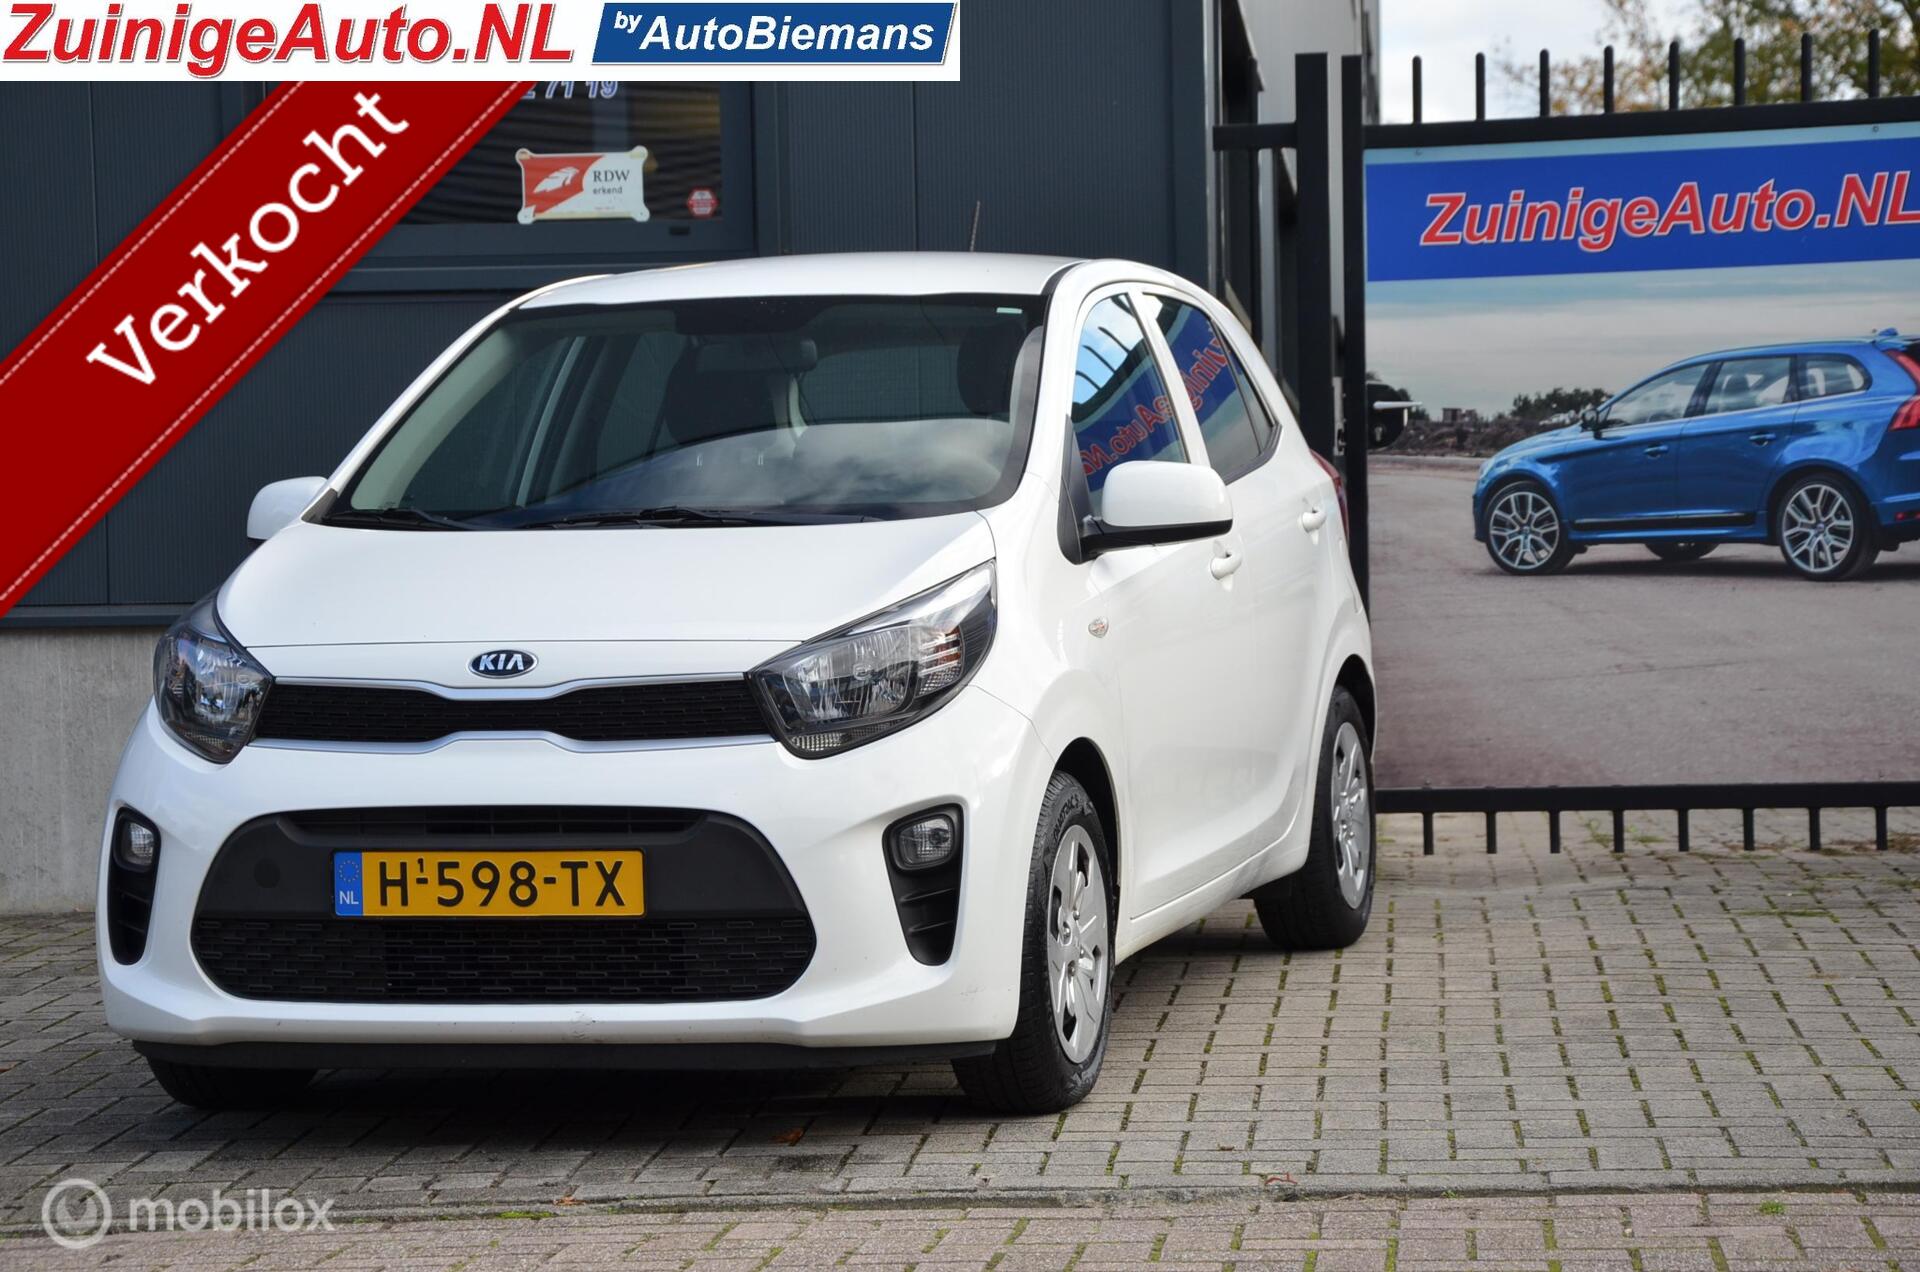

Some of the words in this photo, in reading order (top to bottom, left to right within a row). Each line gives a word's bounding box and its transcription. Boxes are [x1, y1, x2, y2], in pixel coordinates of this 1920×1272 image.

[593, 169, 630, 182] RDW
[592, 186, 623, 195] erkend
[1420, 171, 1920, 253] ZuinigeAuto.NL
[479, 653, 524, 671] KIA
[339, 891, 359, 905] NL
